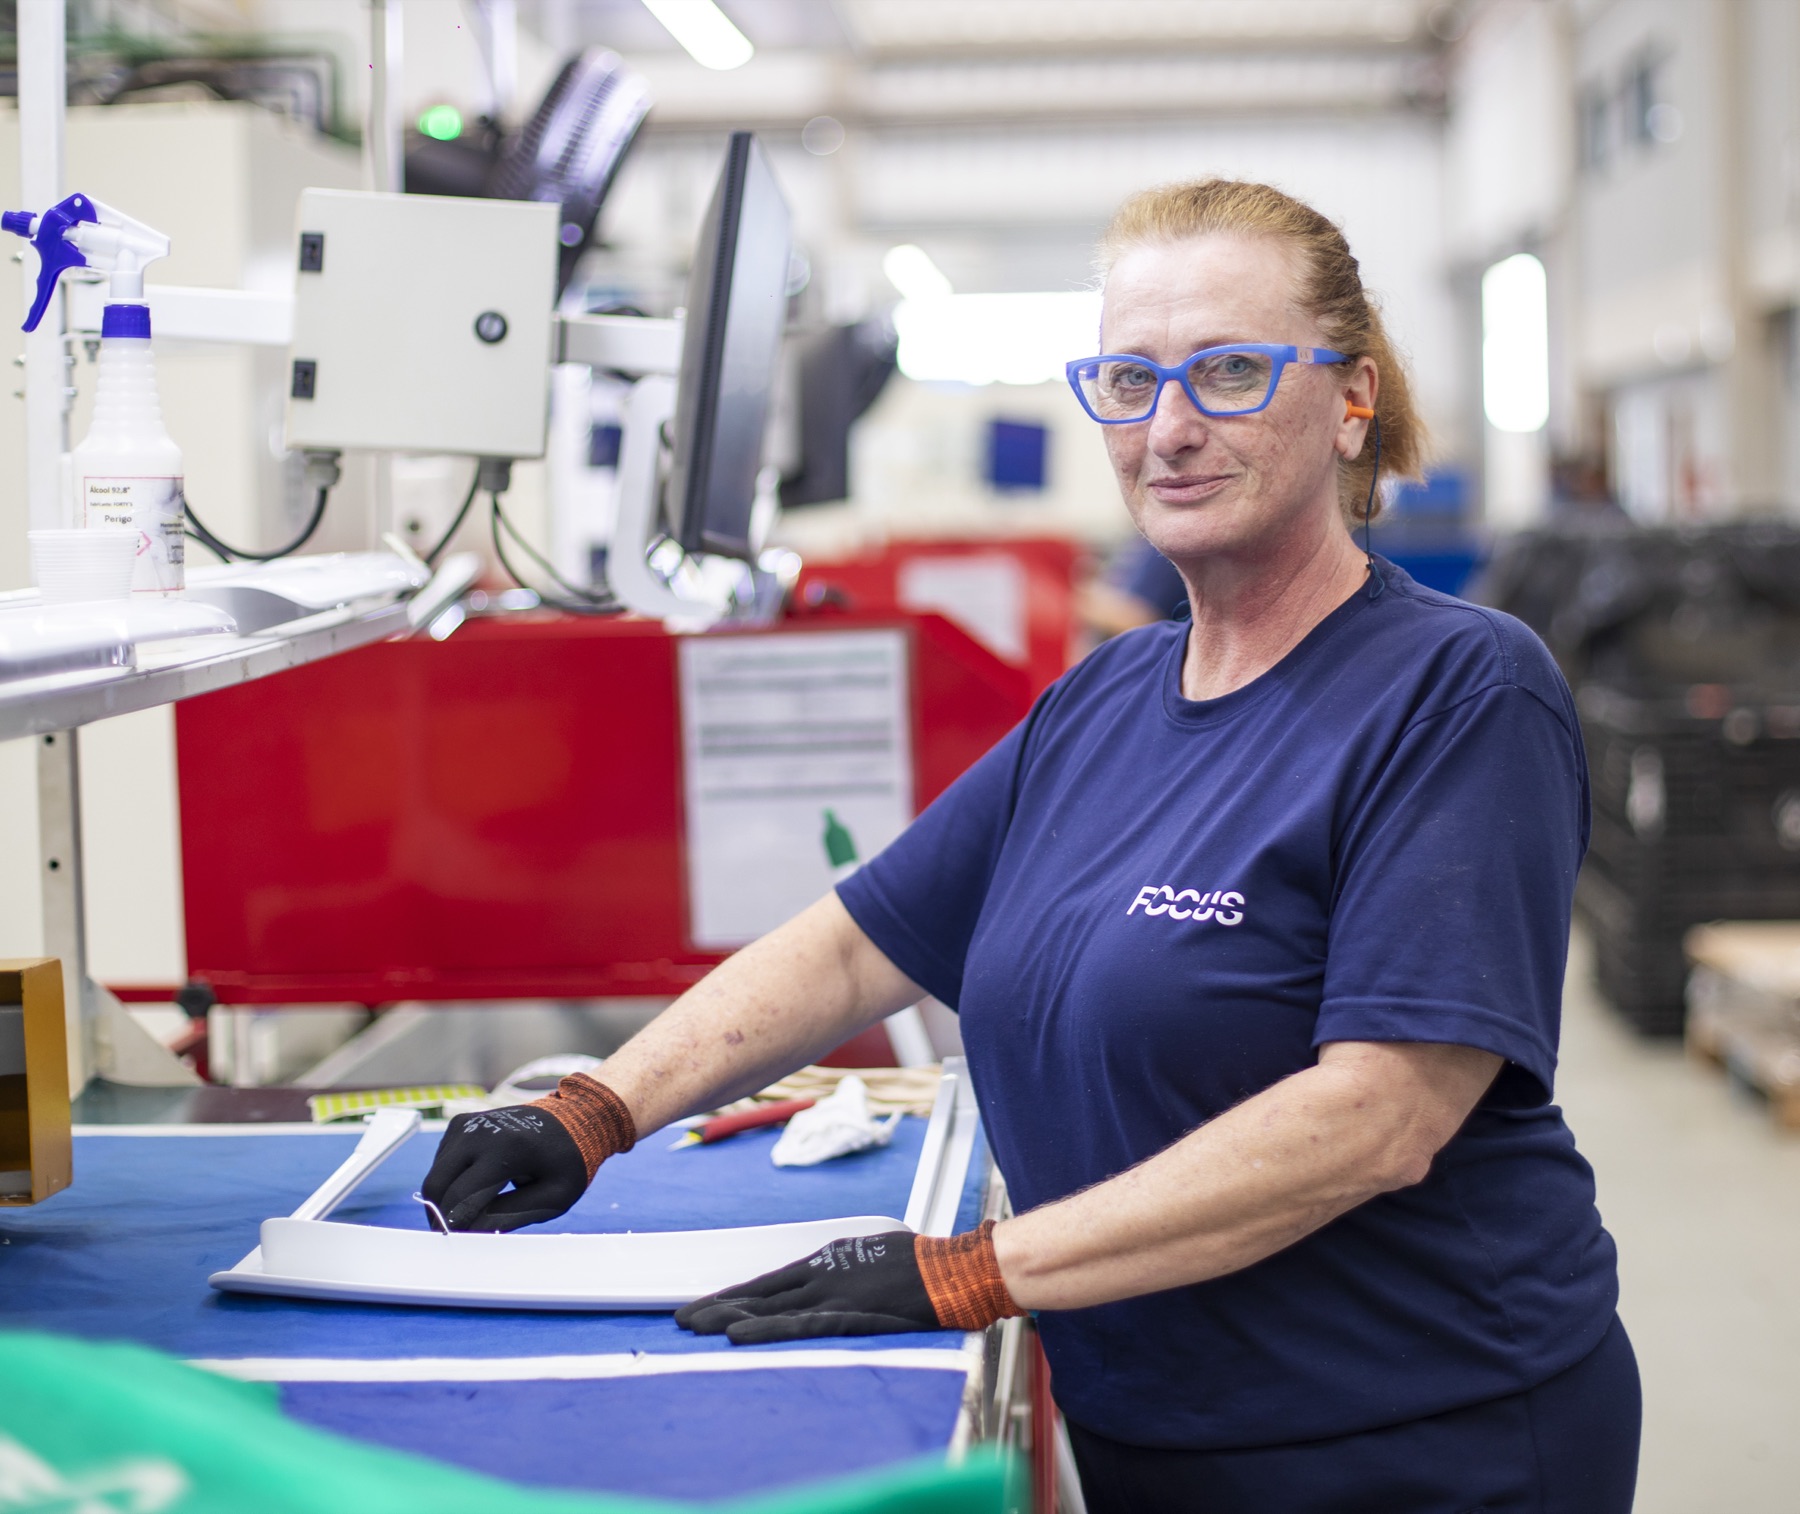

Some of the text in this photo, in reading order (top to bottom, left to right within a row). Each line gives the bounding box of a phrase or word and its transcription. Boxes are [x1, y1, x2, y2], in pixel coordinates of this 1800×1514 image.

[90, 485, 110, 494] Álcool
[104, 515, 132, 524] Perigo
[1126, 884, 1246, 926] FOCUS
